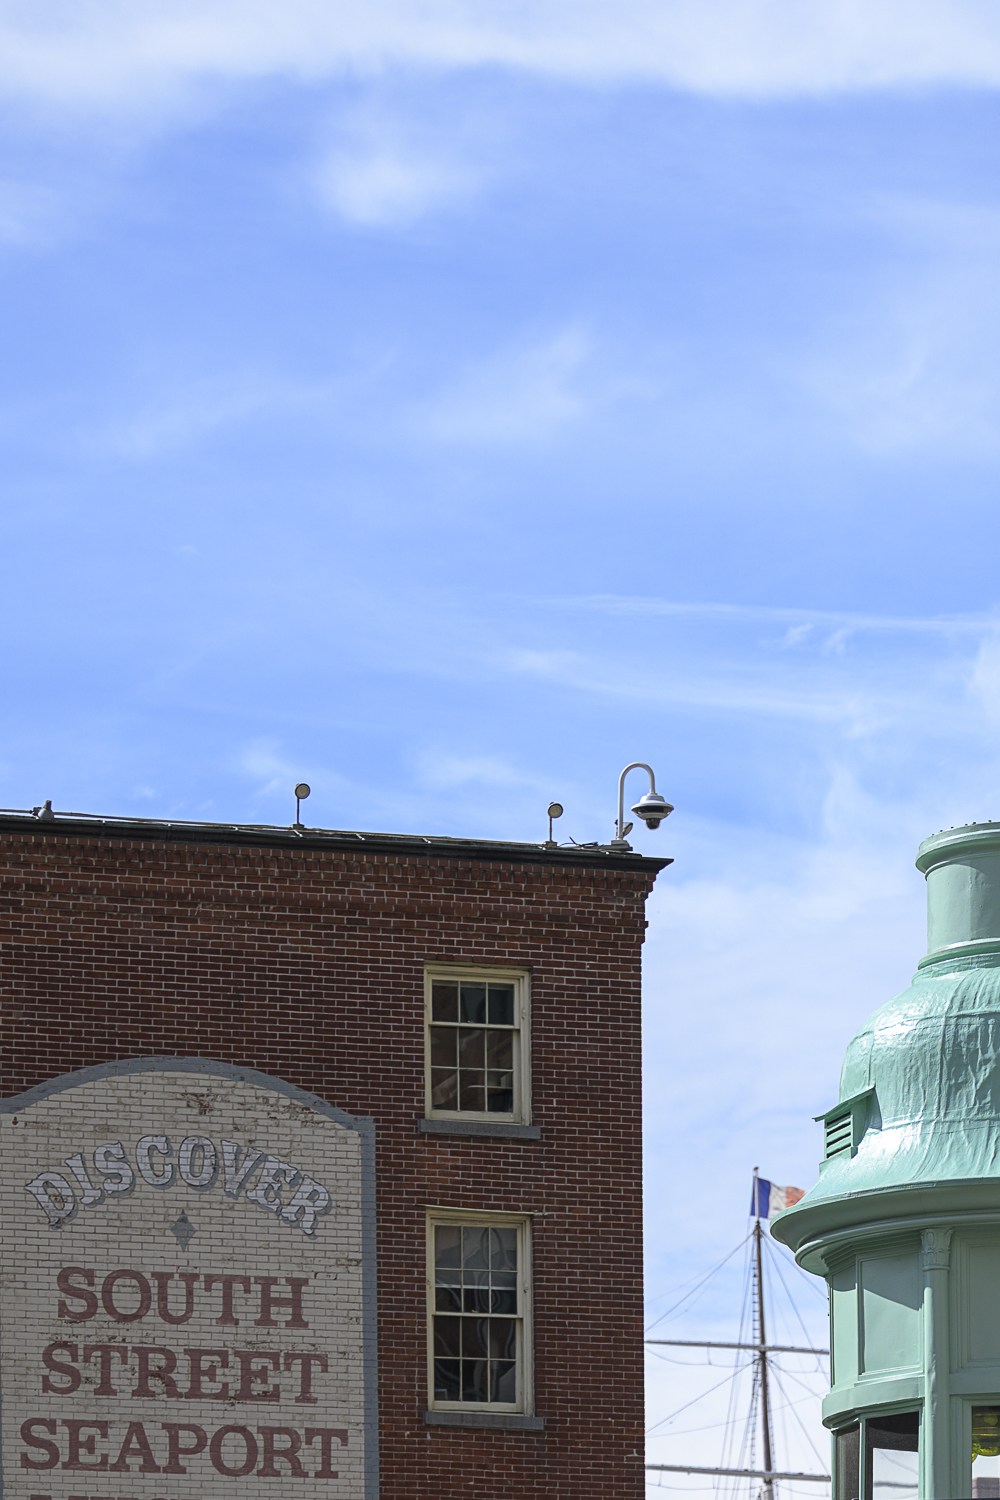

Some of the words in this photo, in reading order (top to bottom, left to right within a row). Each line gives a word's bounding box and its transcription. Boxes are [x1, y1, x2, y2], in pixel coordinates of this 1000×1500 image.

[24, 1135, 332, 1237] DISCOVER
[57, 1267, 309, 1328] SOUTH
[41, 1343, 328, 1404] STREET
[19, 1418, 348, 1479] SEAPORT
